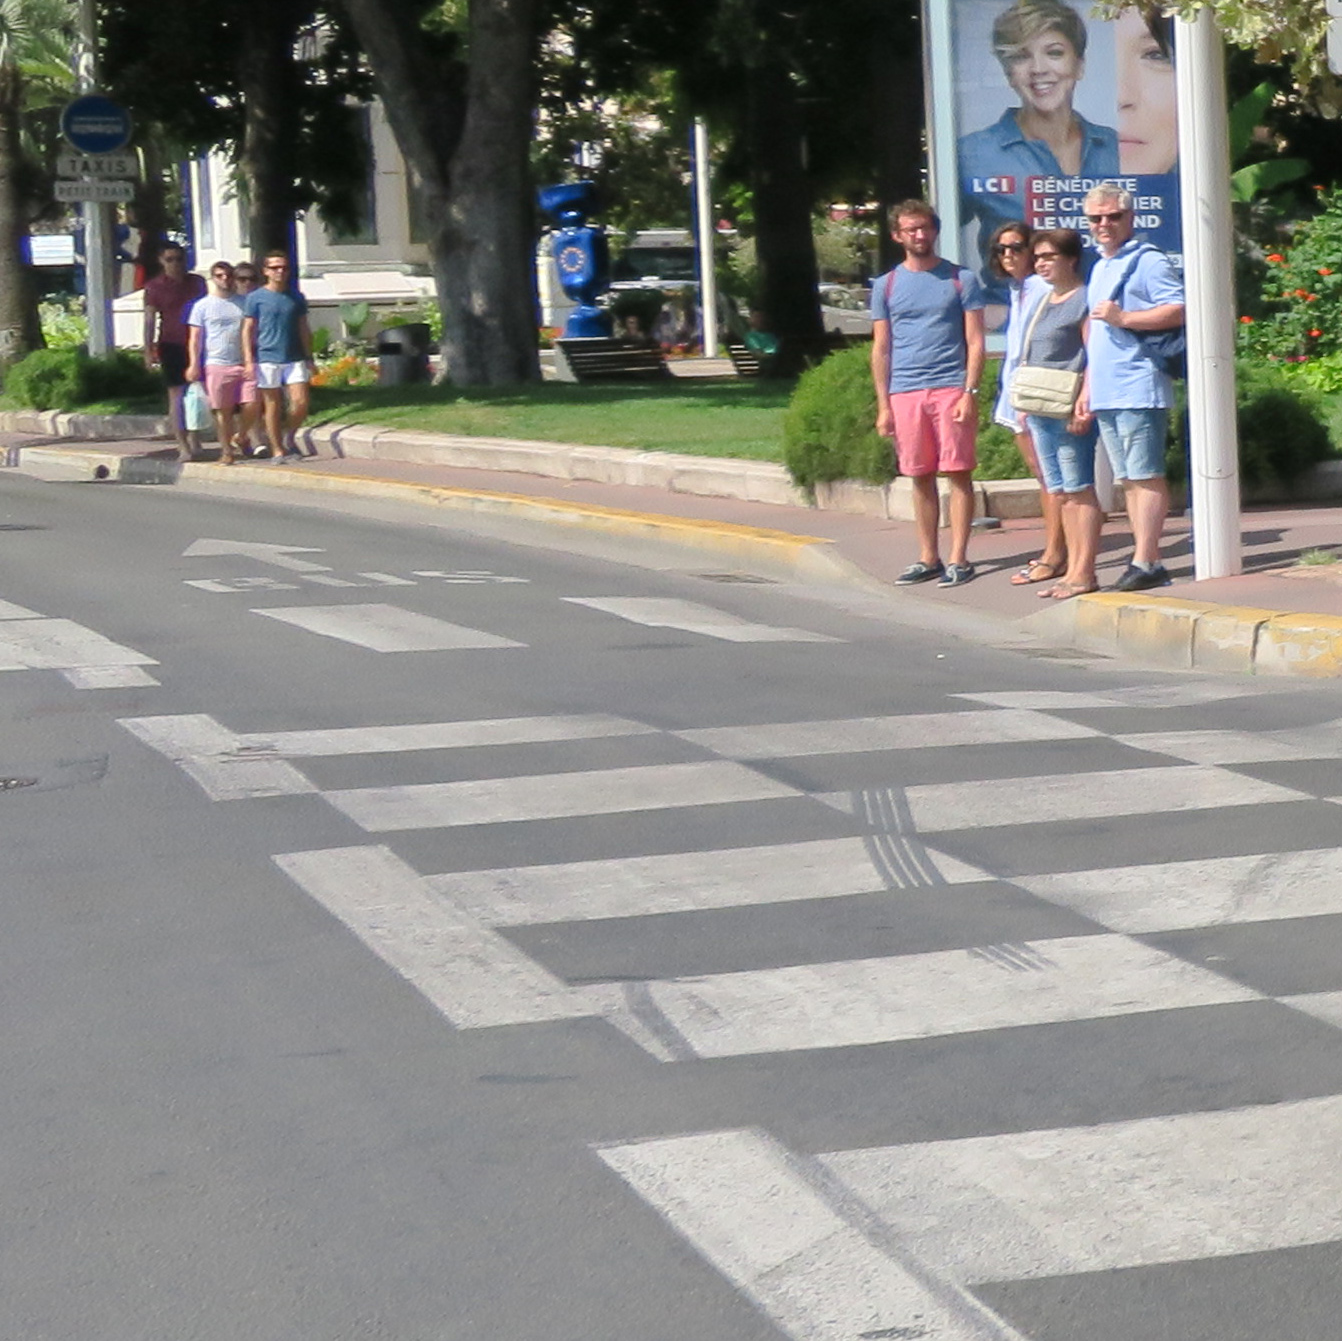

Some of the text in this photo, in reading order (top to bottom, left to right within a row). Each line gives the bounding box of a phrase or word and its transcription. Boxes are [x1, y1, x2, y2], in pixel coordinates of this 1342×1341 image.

[70, 159, 127, 173] TAXIS
[973, 179, 1009, 193] LCI
[1033, 199, 1056, 212] LE
[1034, 217, 1056, 230] LE
[183, 570, 531, 593] BUS
